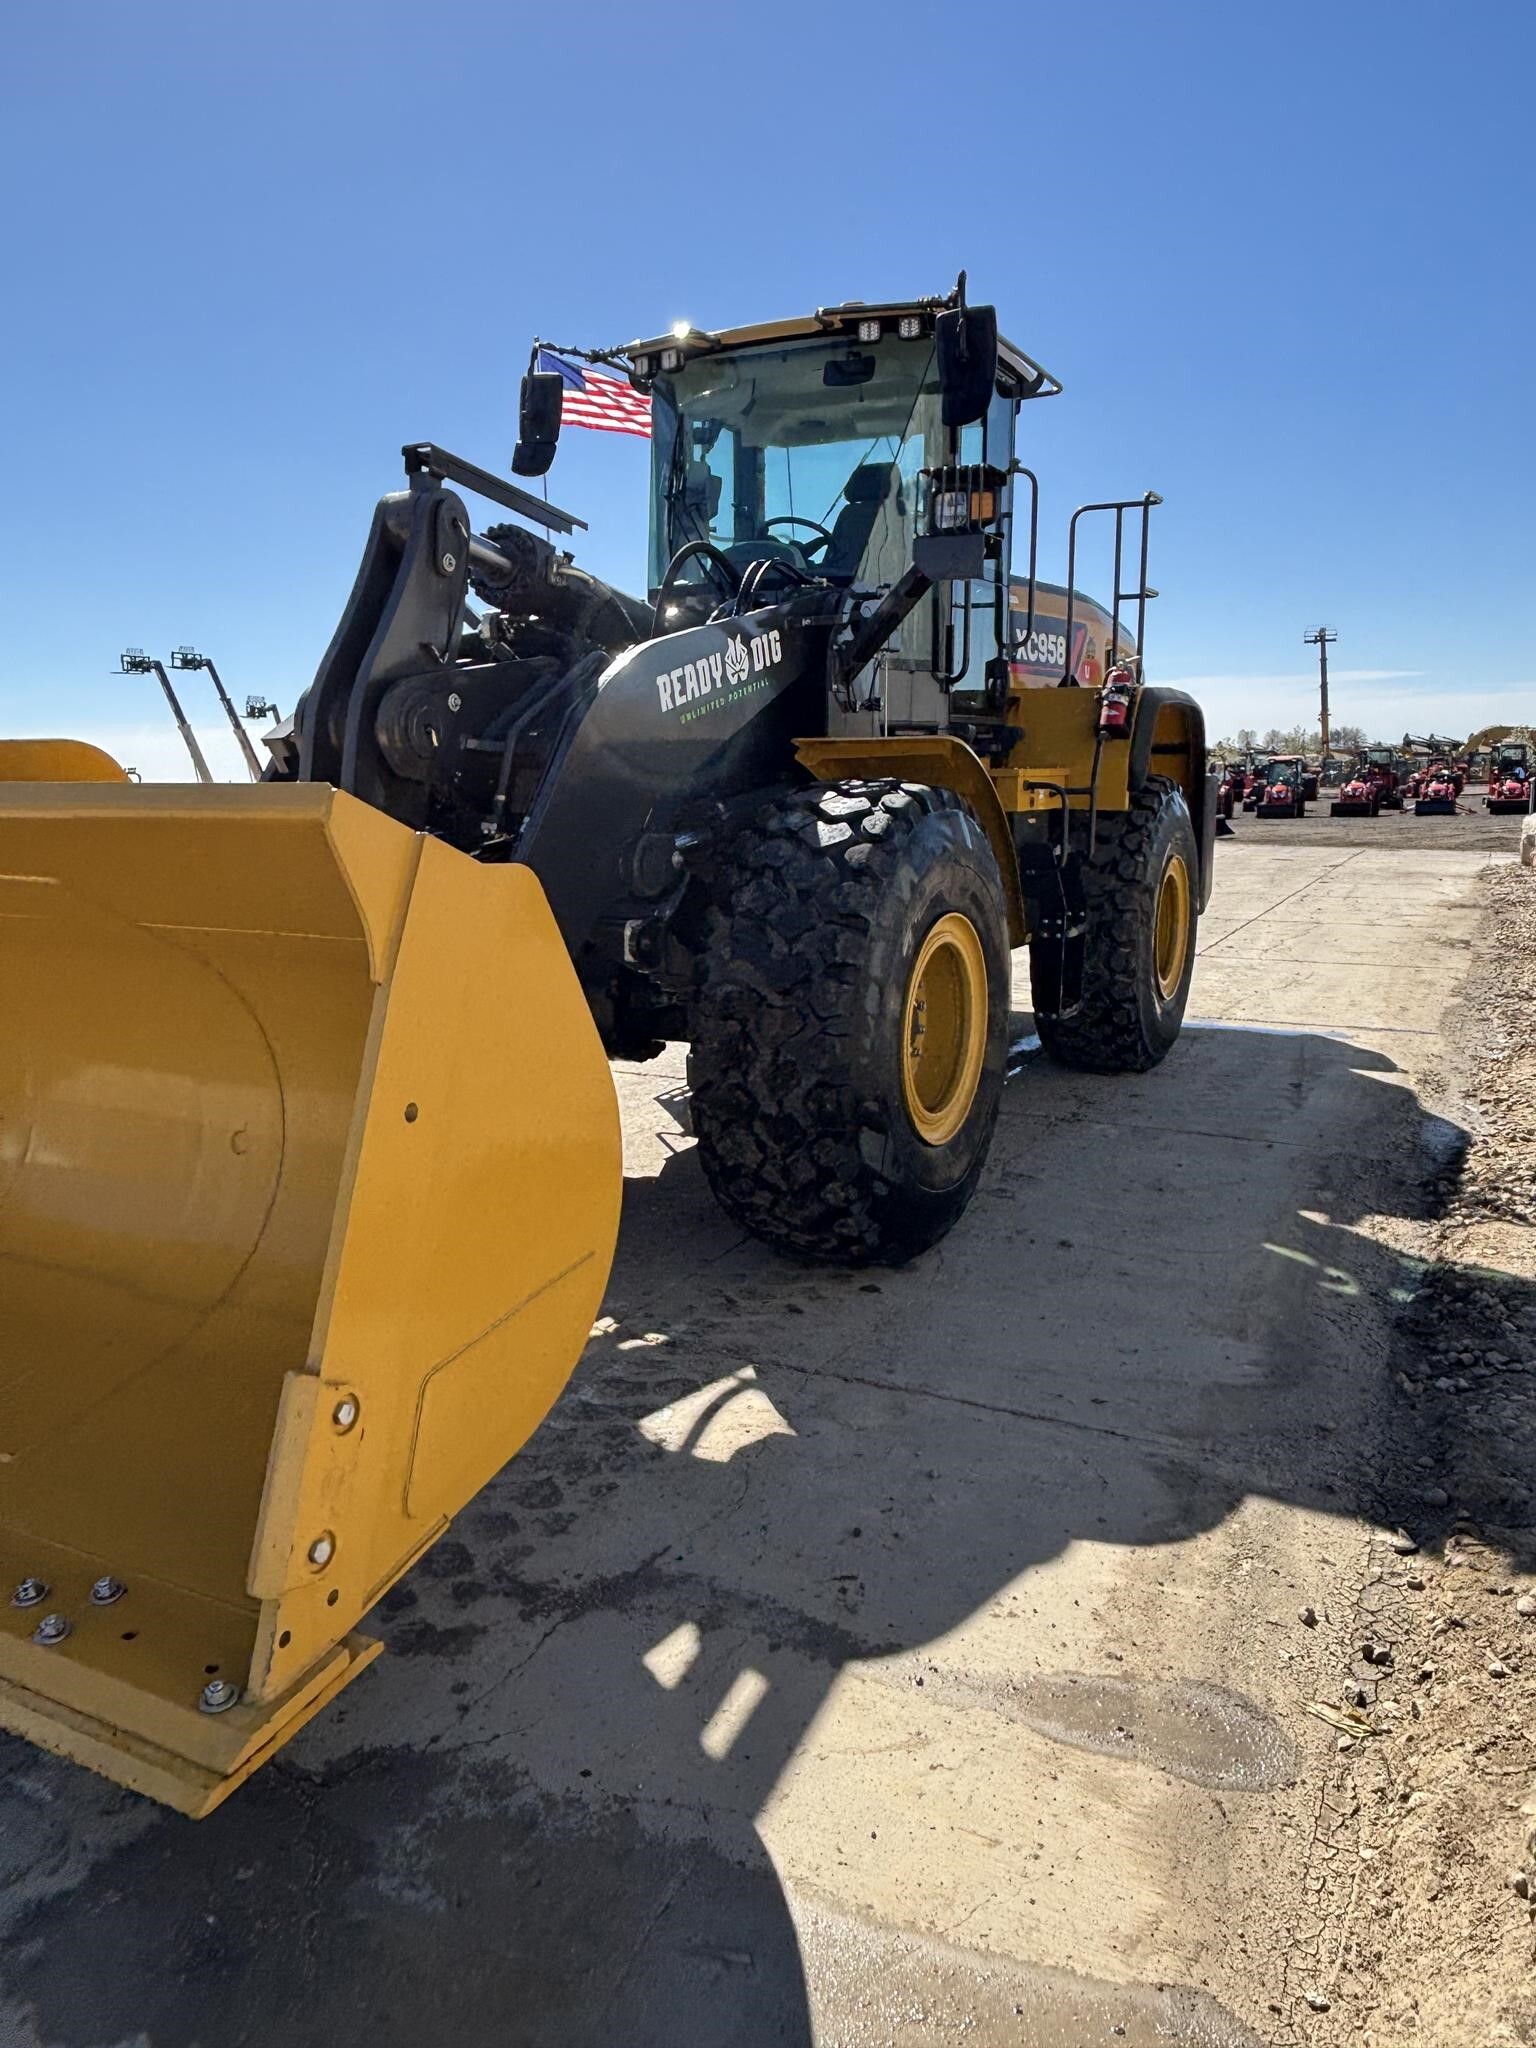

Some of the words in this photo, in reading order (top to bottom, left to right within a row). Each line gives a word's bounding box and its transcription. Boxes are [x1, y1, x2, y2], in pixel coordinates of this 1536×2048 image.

[1015, 628, 1066, 665] XC958
[656, 652, 723, 713] READY
[750, 629, 782, 672] DIG
[680, 698, 725, 724] UNLIMITED
[728, 677, 769, 702] POTENTIAL
